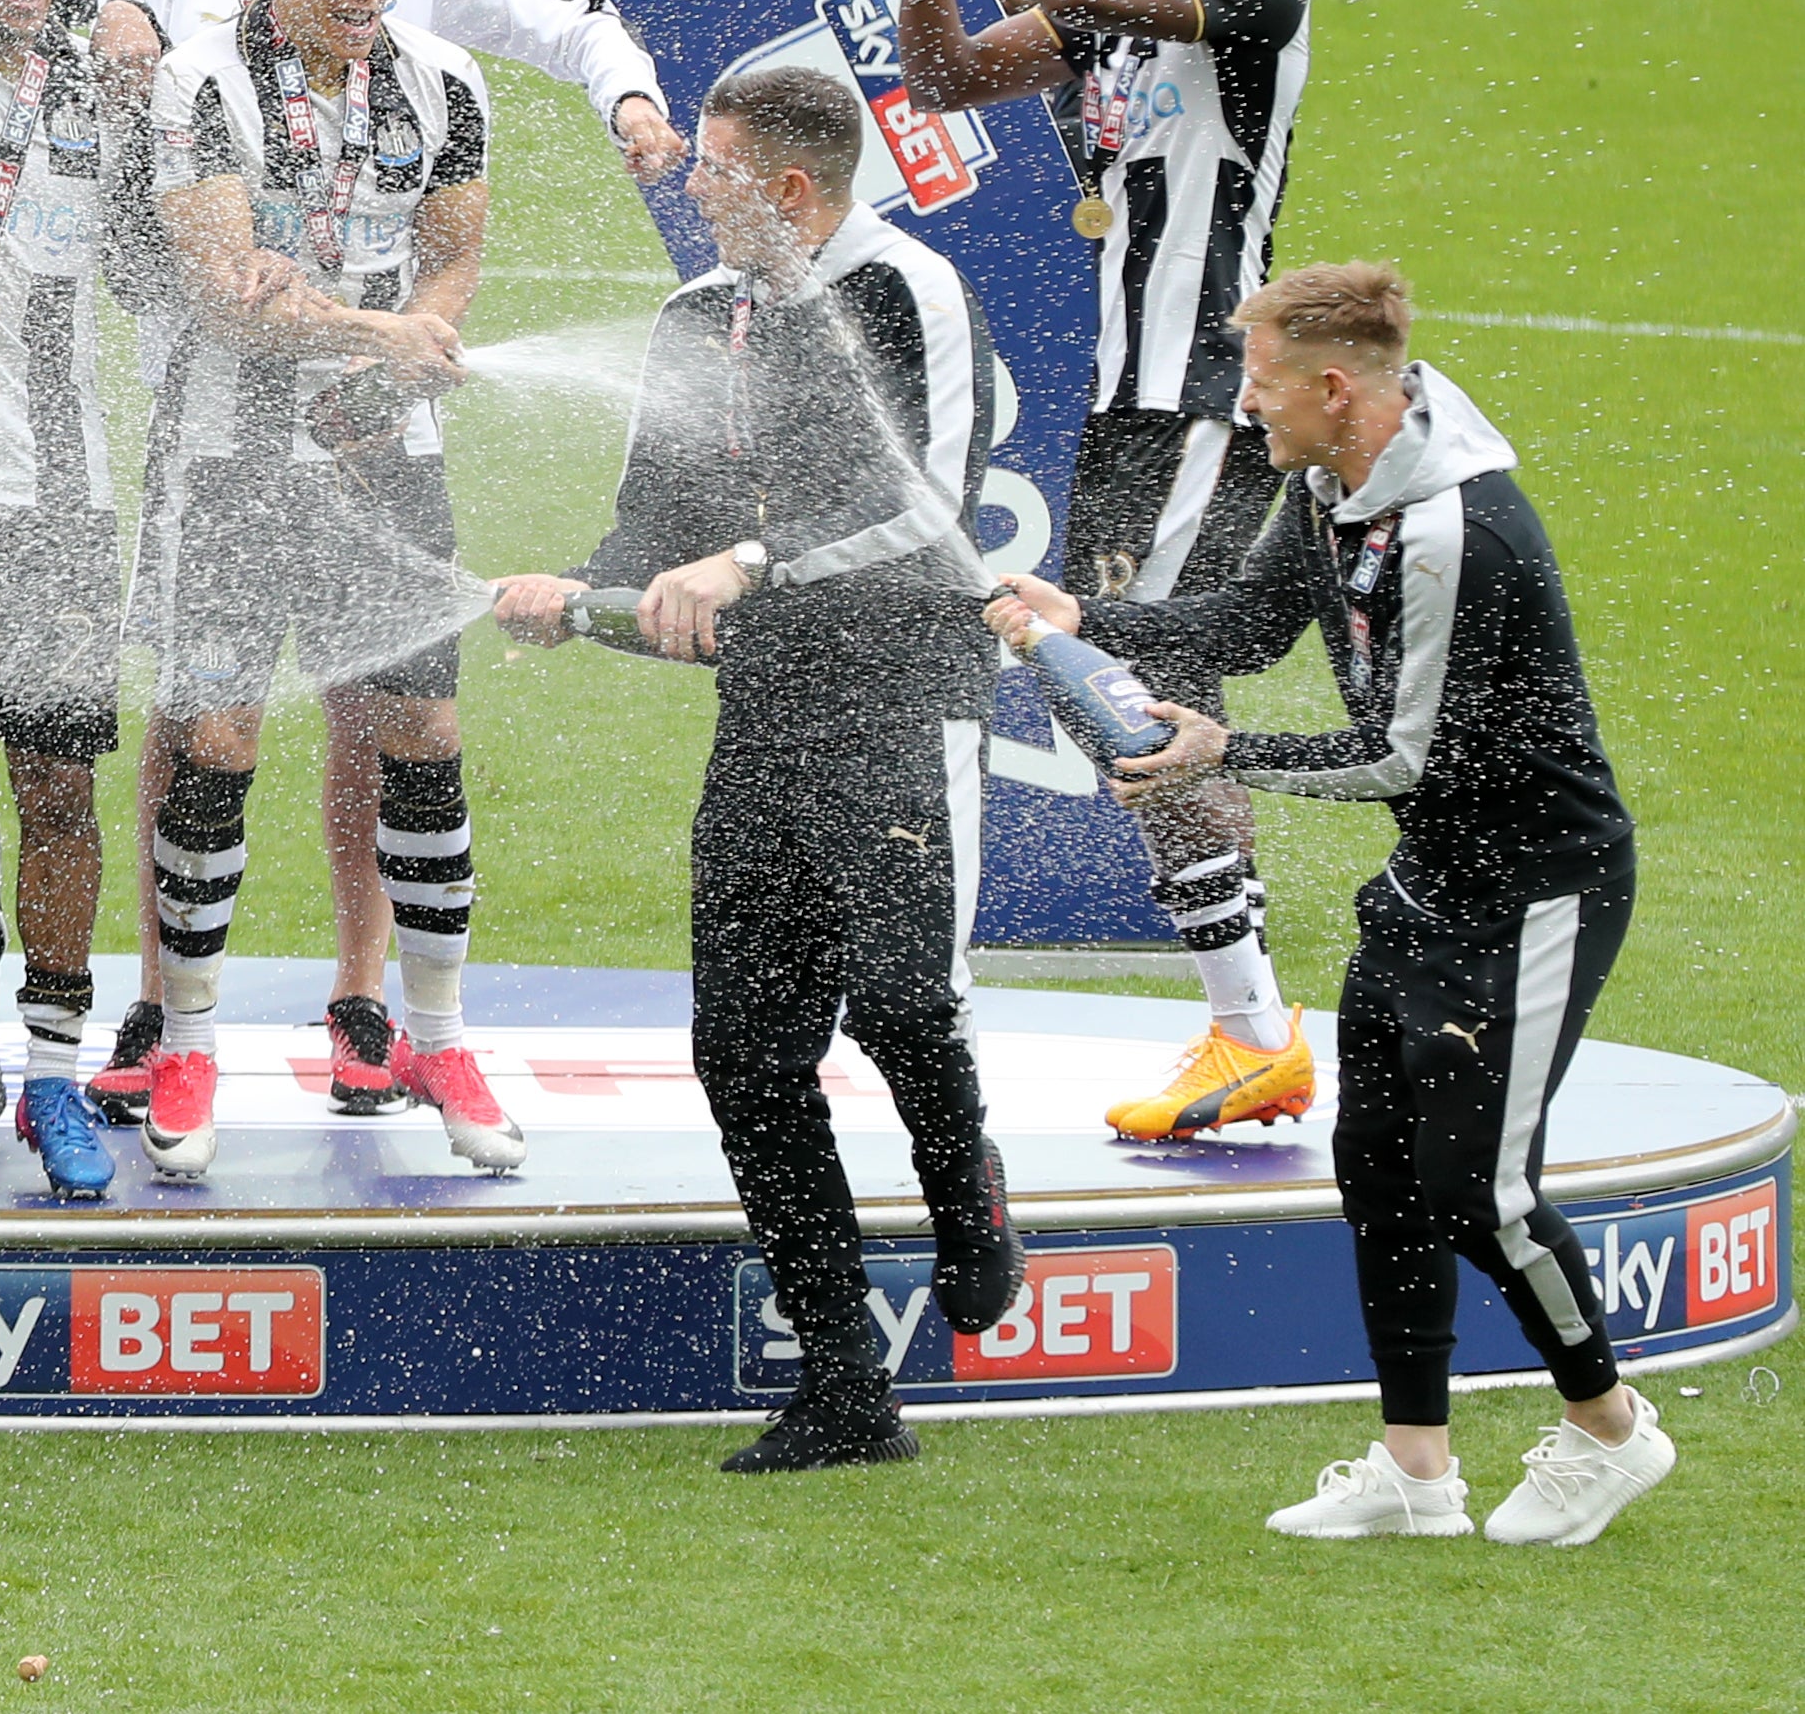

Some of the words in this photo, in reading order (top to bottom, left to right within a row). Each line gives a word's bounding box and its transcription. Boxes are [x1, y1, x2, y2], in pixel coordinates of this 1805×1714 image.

[885, 97, 958, 185] BET
[1699, 1206, 1770, 1303] BET
[98, 1290, 294, 1372] BET
[761, 1285, 932, 1376] sy
[984, 1272, 1151, 1361] BET
